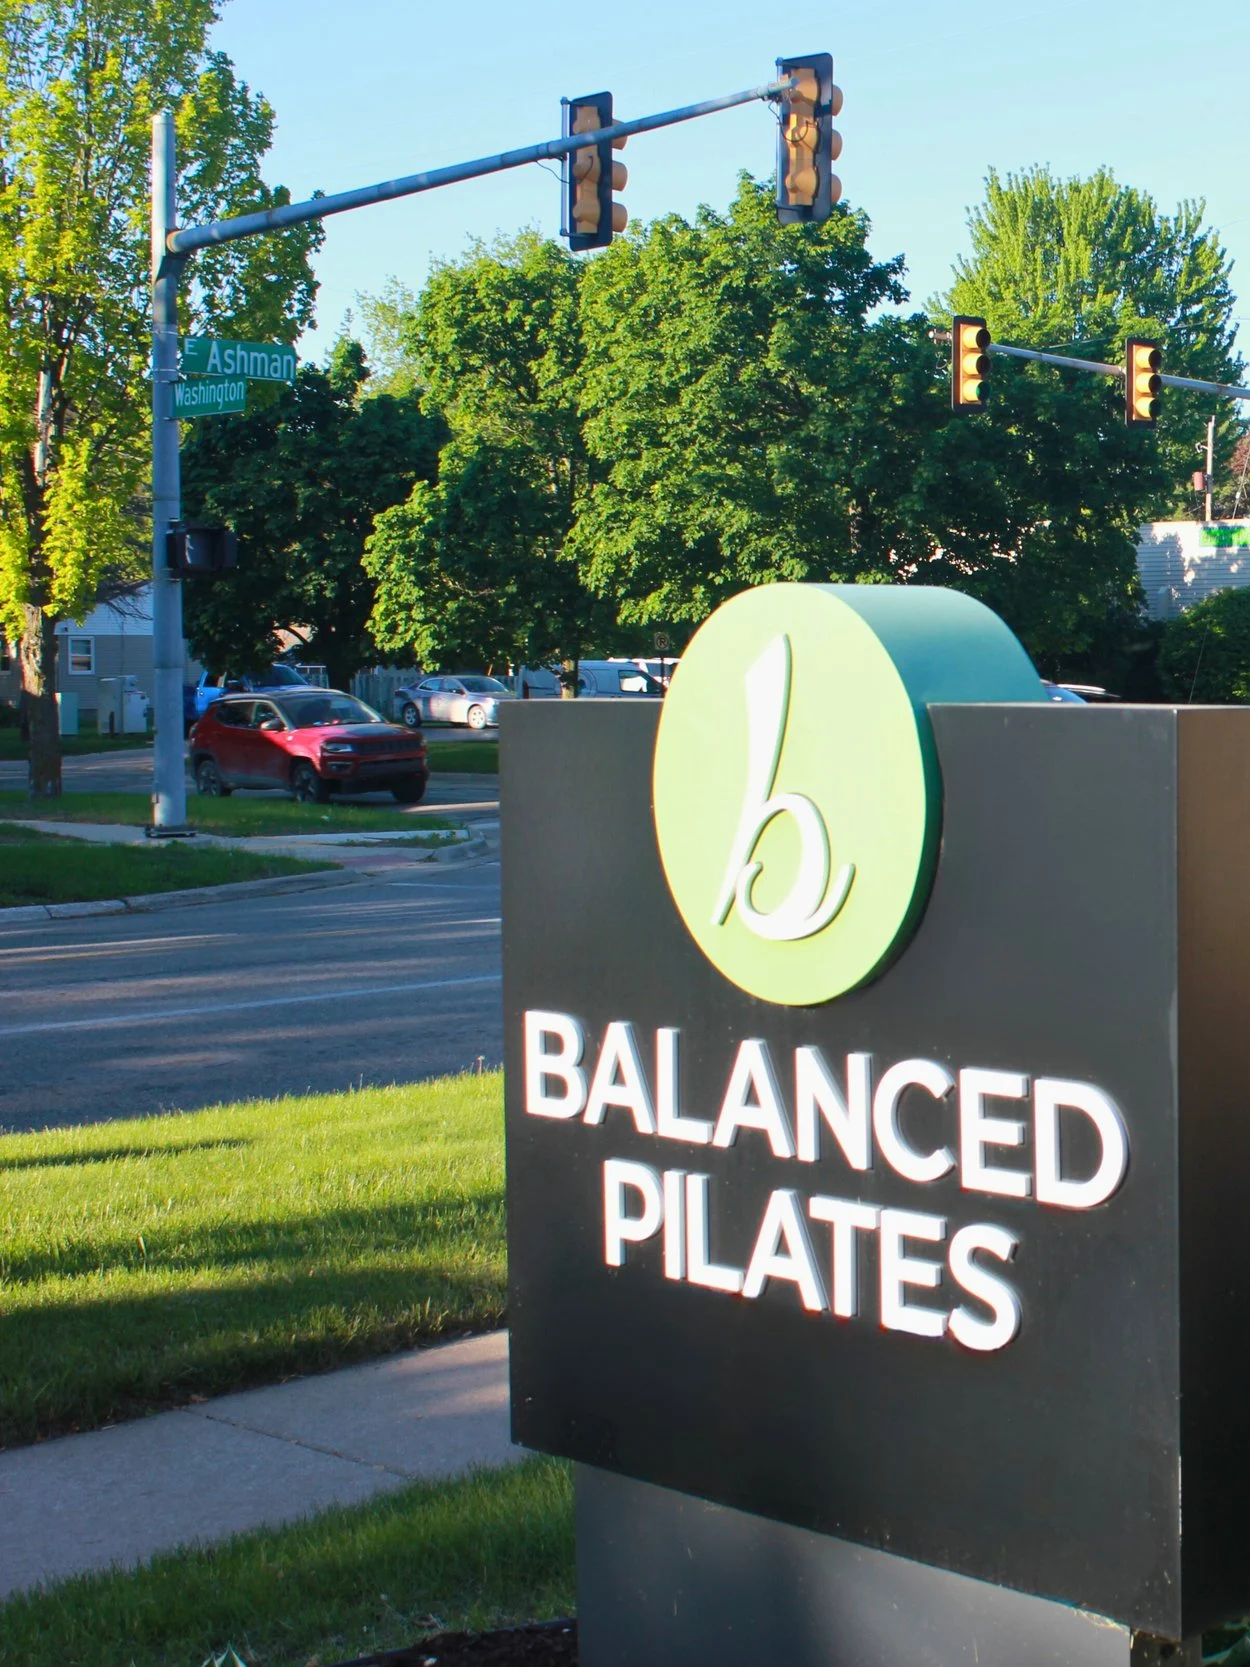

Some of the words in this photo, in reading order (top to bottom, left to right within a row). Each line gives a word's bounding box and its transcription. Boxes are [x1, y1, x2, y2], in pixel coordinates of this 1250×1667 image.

[174, 381, 244, 410] Washington
[184, 338, 198, 355] E
[207, 341, 295, 378] Ashman
[523, 1009, 1131, 1209] BALANCED
[603, 1158, 1023, 1351] PILATES
